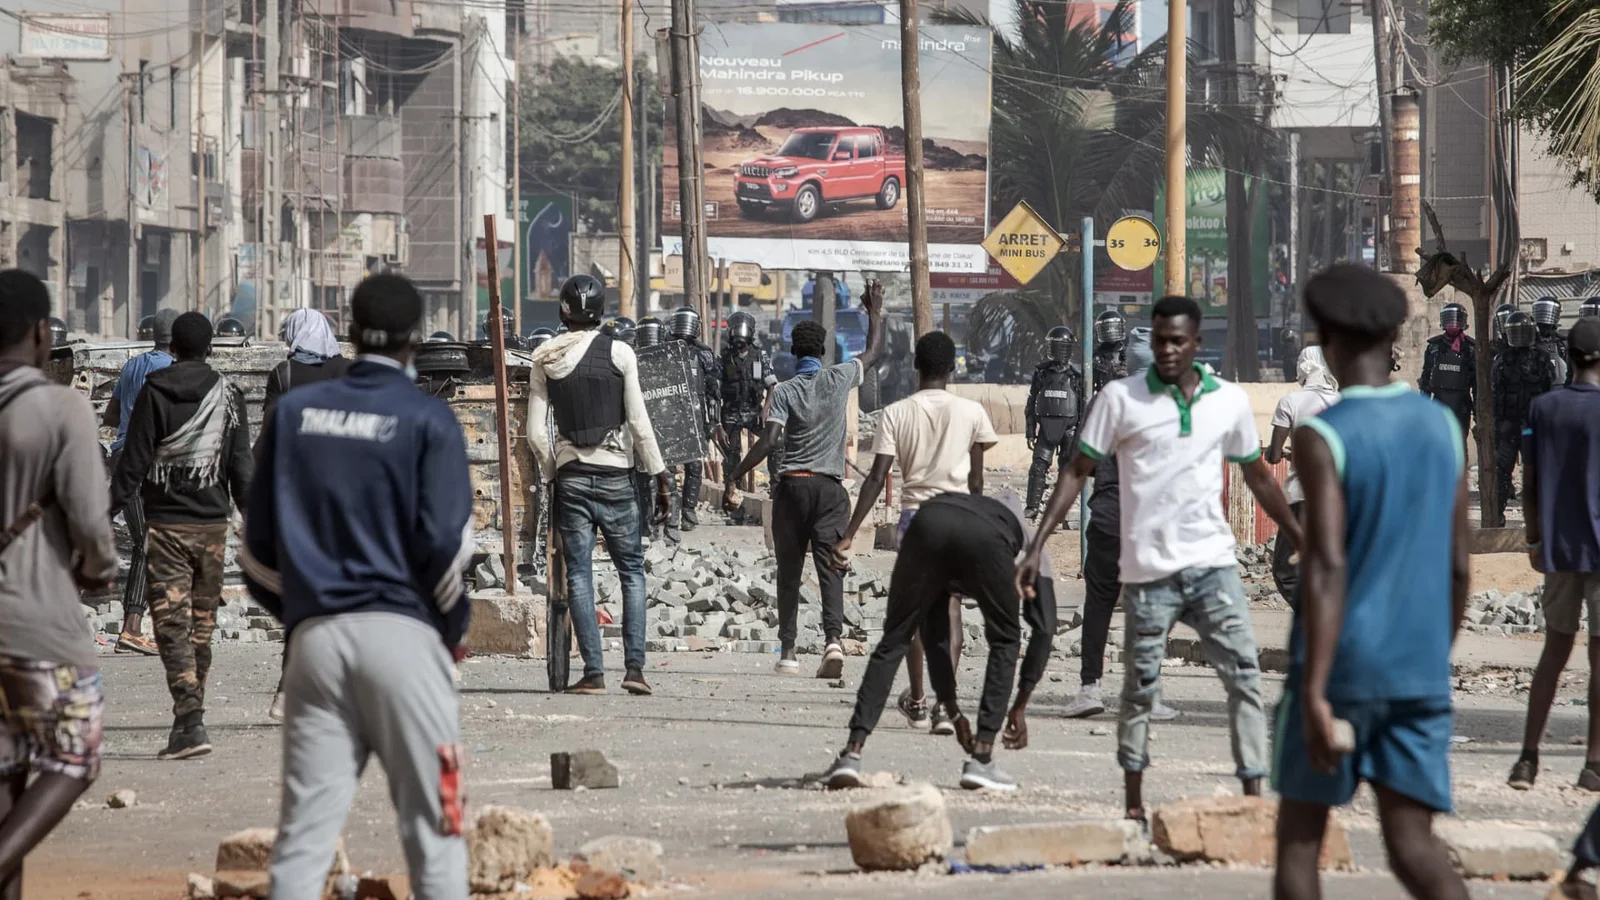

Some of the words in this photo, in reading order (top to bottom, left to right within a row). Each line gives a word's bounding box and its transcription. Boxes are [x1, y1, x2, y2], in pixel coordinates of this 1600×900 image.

[881, 38, 966, 52] mindra
[699, 56, 782, 67] Nouveau
[699, 68, 787, 81] Mahindra
[790, 69, 844, 84] Pikup
[1186, 216, 1220, 229] okkoo
[998, 233, 1049, 246] ARRET
[1109, 239, 1125, 249] 35
[1143, 238, 1159, 248] 36
[999, 248, 1022, 258] MINI
[1025, 249, 1046, 258] BUS
[641, 383, 688, 401] NDARMERIE
